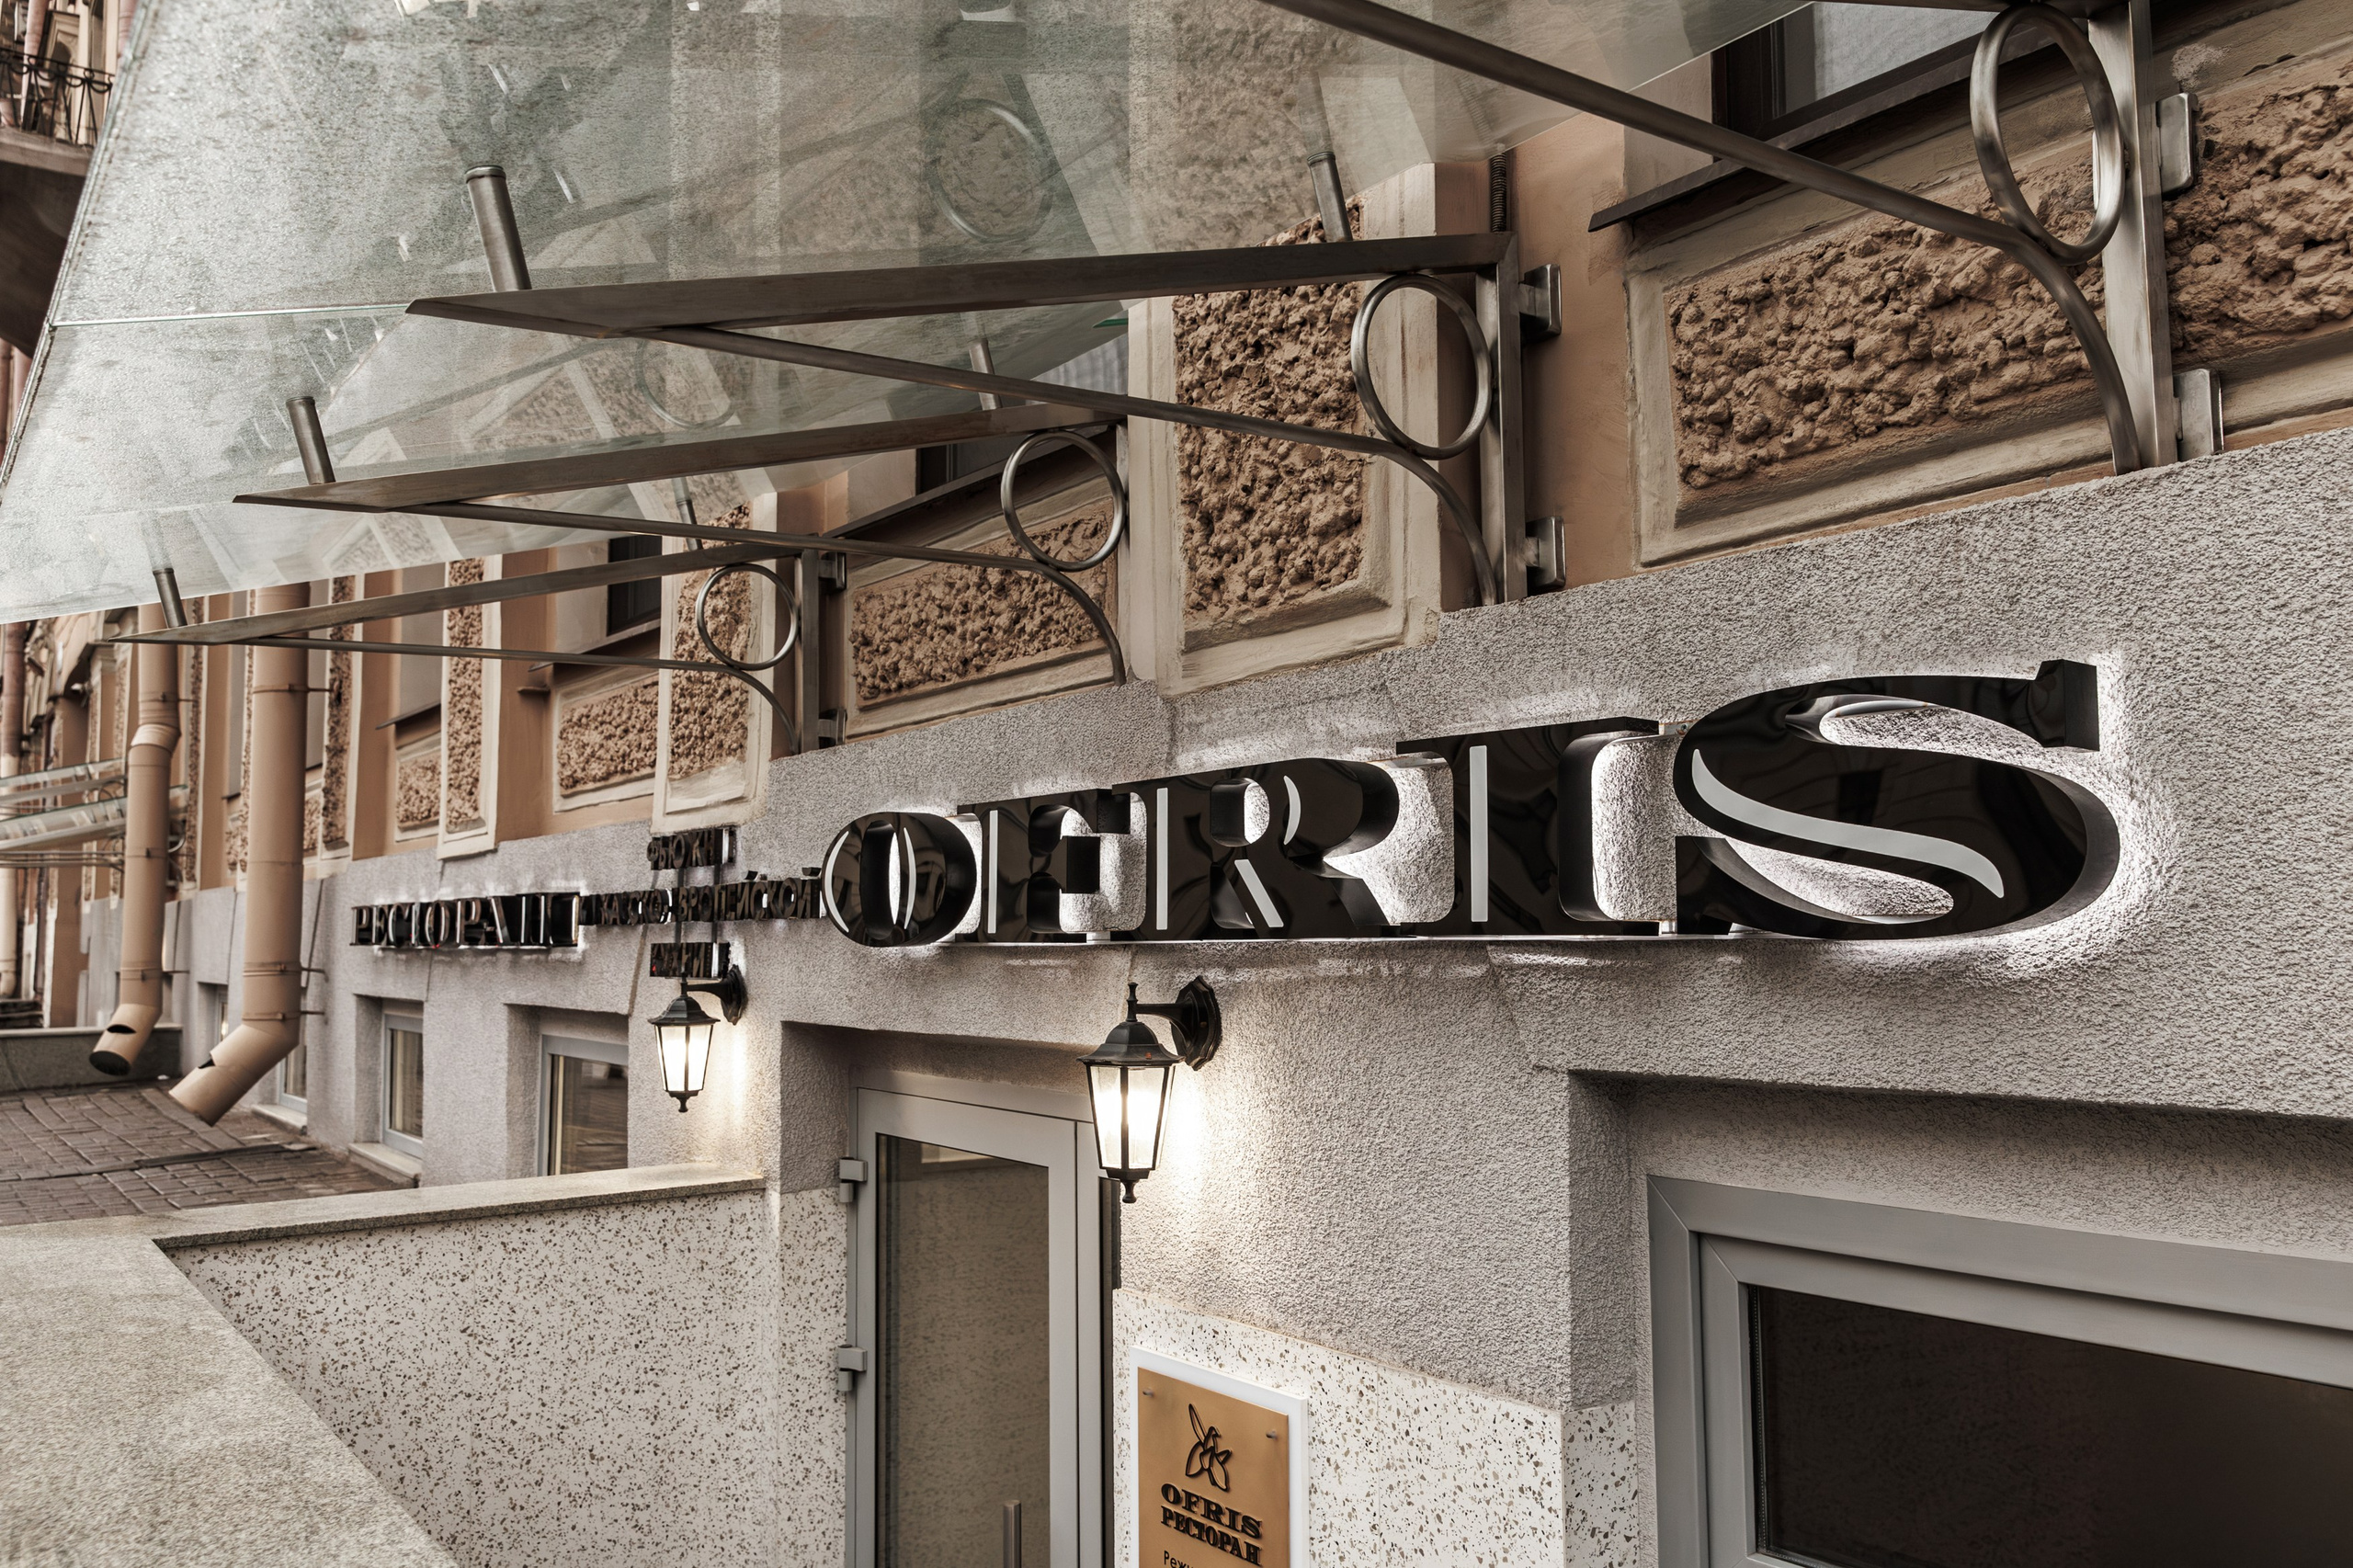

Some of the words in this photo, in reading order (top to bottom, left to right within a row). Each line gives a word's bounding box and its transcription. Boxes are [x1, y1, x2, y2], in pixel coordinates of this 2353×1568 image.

[822, 658, 2120, 947] OFRIS
[350, 892, 581, 948] РЕСТОРАН
[1161, 1483, 1263, 1539] OFRIS
[1161, 1505, 1263, 1568] РЕСТОРАН
[1164, 1550, 1194, 1568] Реж
